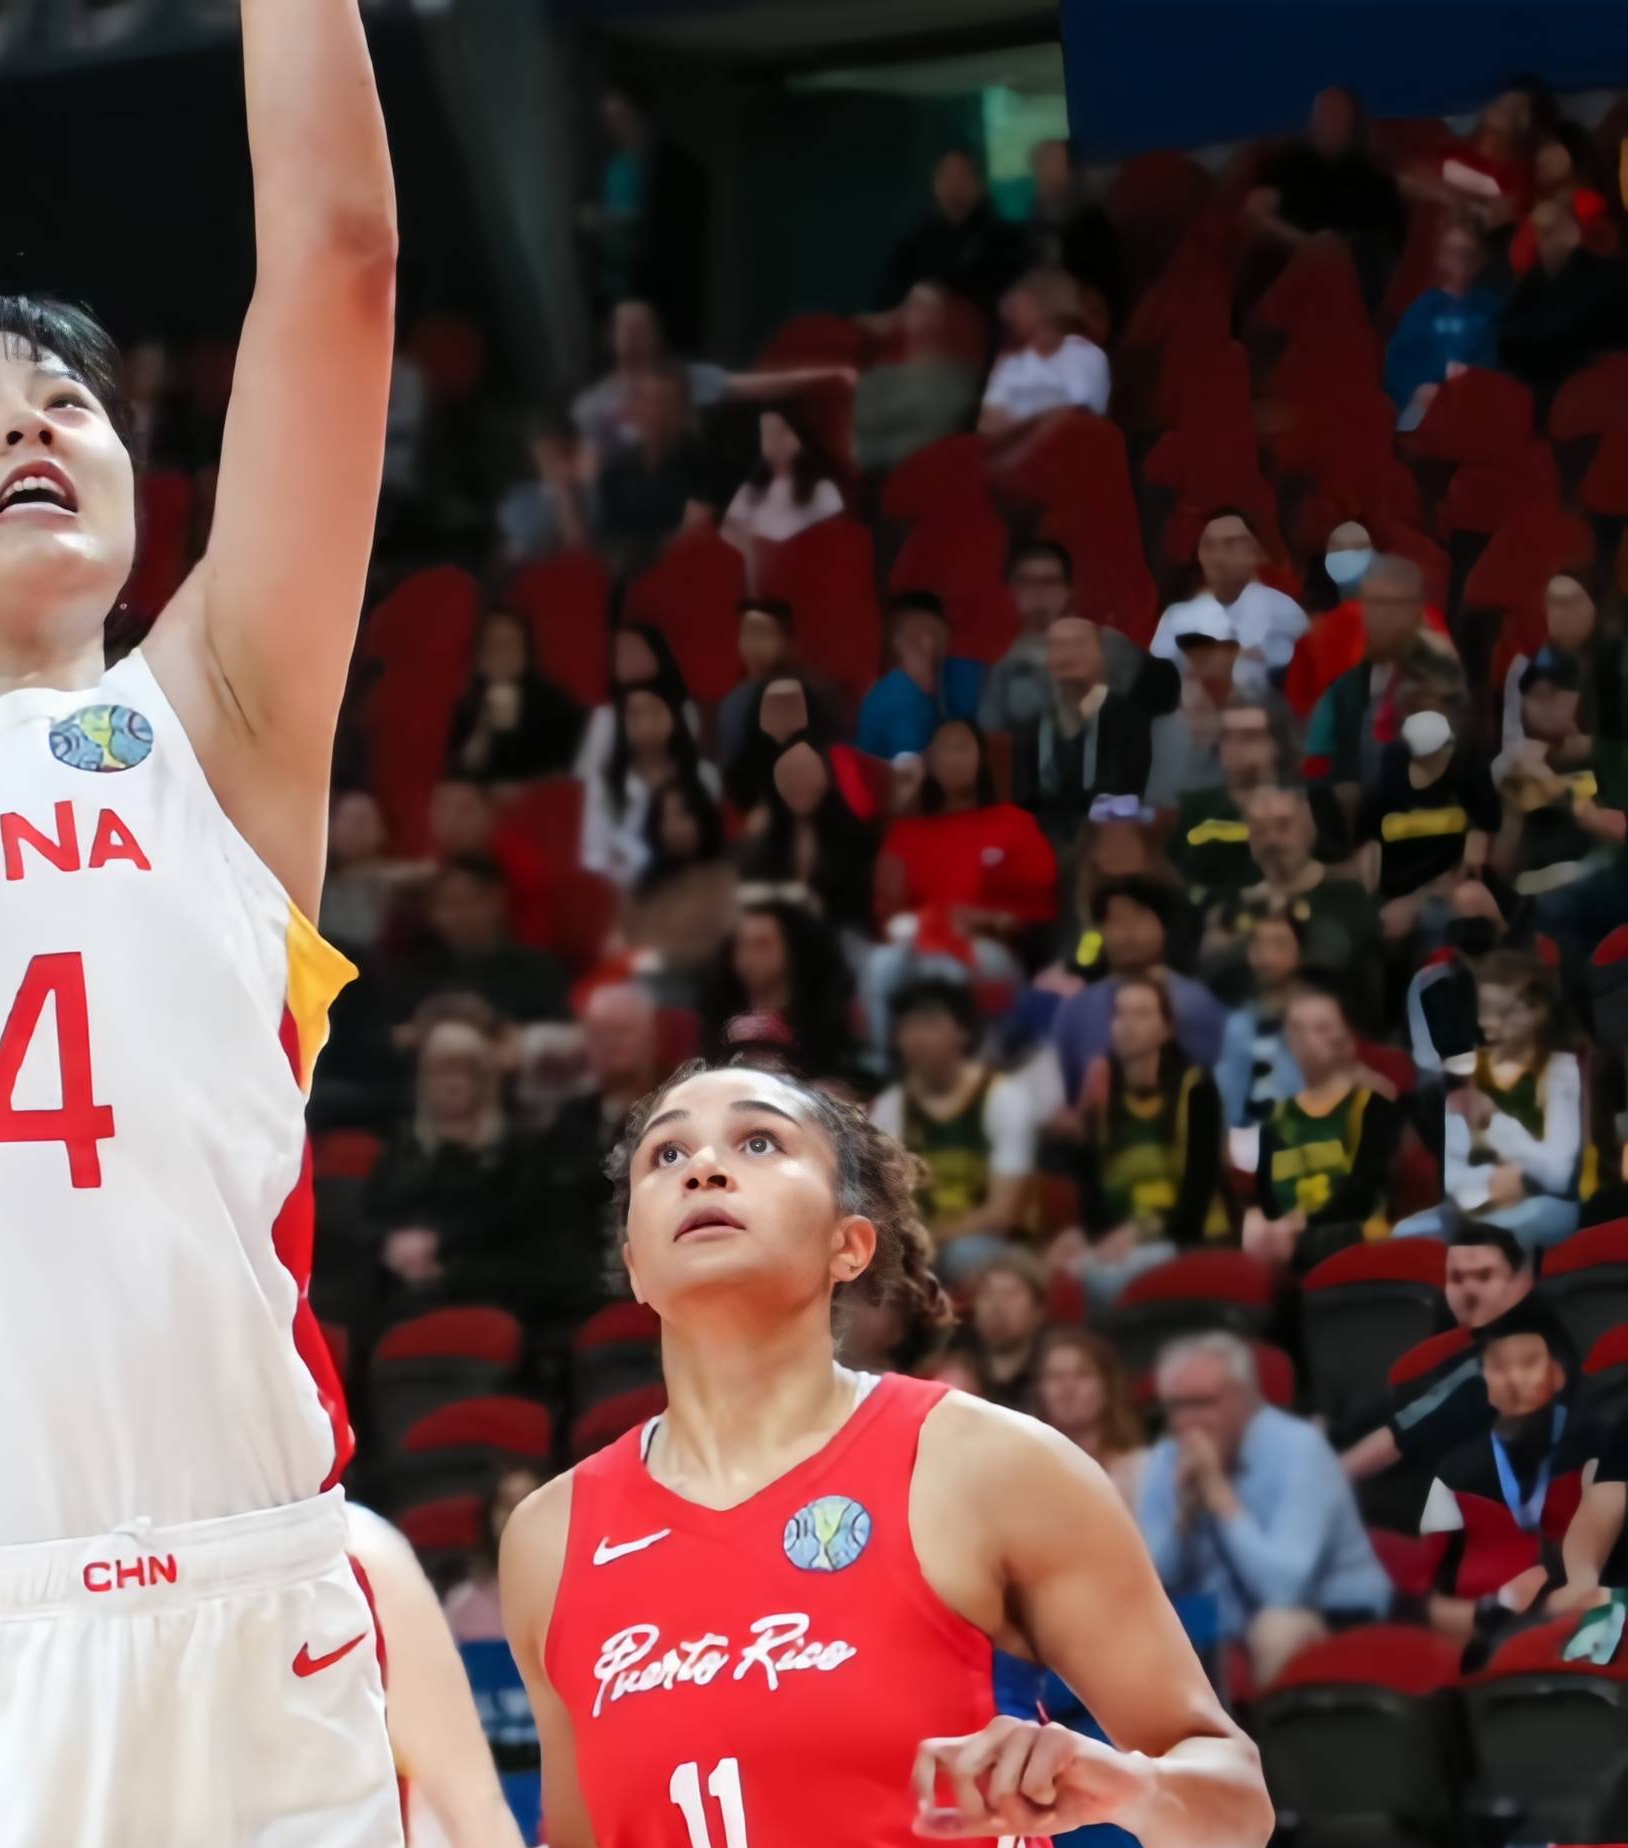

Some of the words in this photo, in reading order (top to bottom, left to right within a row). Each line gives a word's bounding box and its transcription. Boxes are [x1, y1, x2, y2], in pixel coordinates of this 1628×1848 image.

[82, 1553, 178, 1593] CHN
[592, 1623, 730, 1718] Puerto
[732, 1612, 858, 1691] Rico
